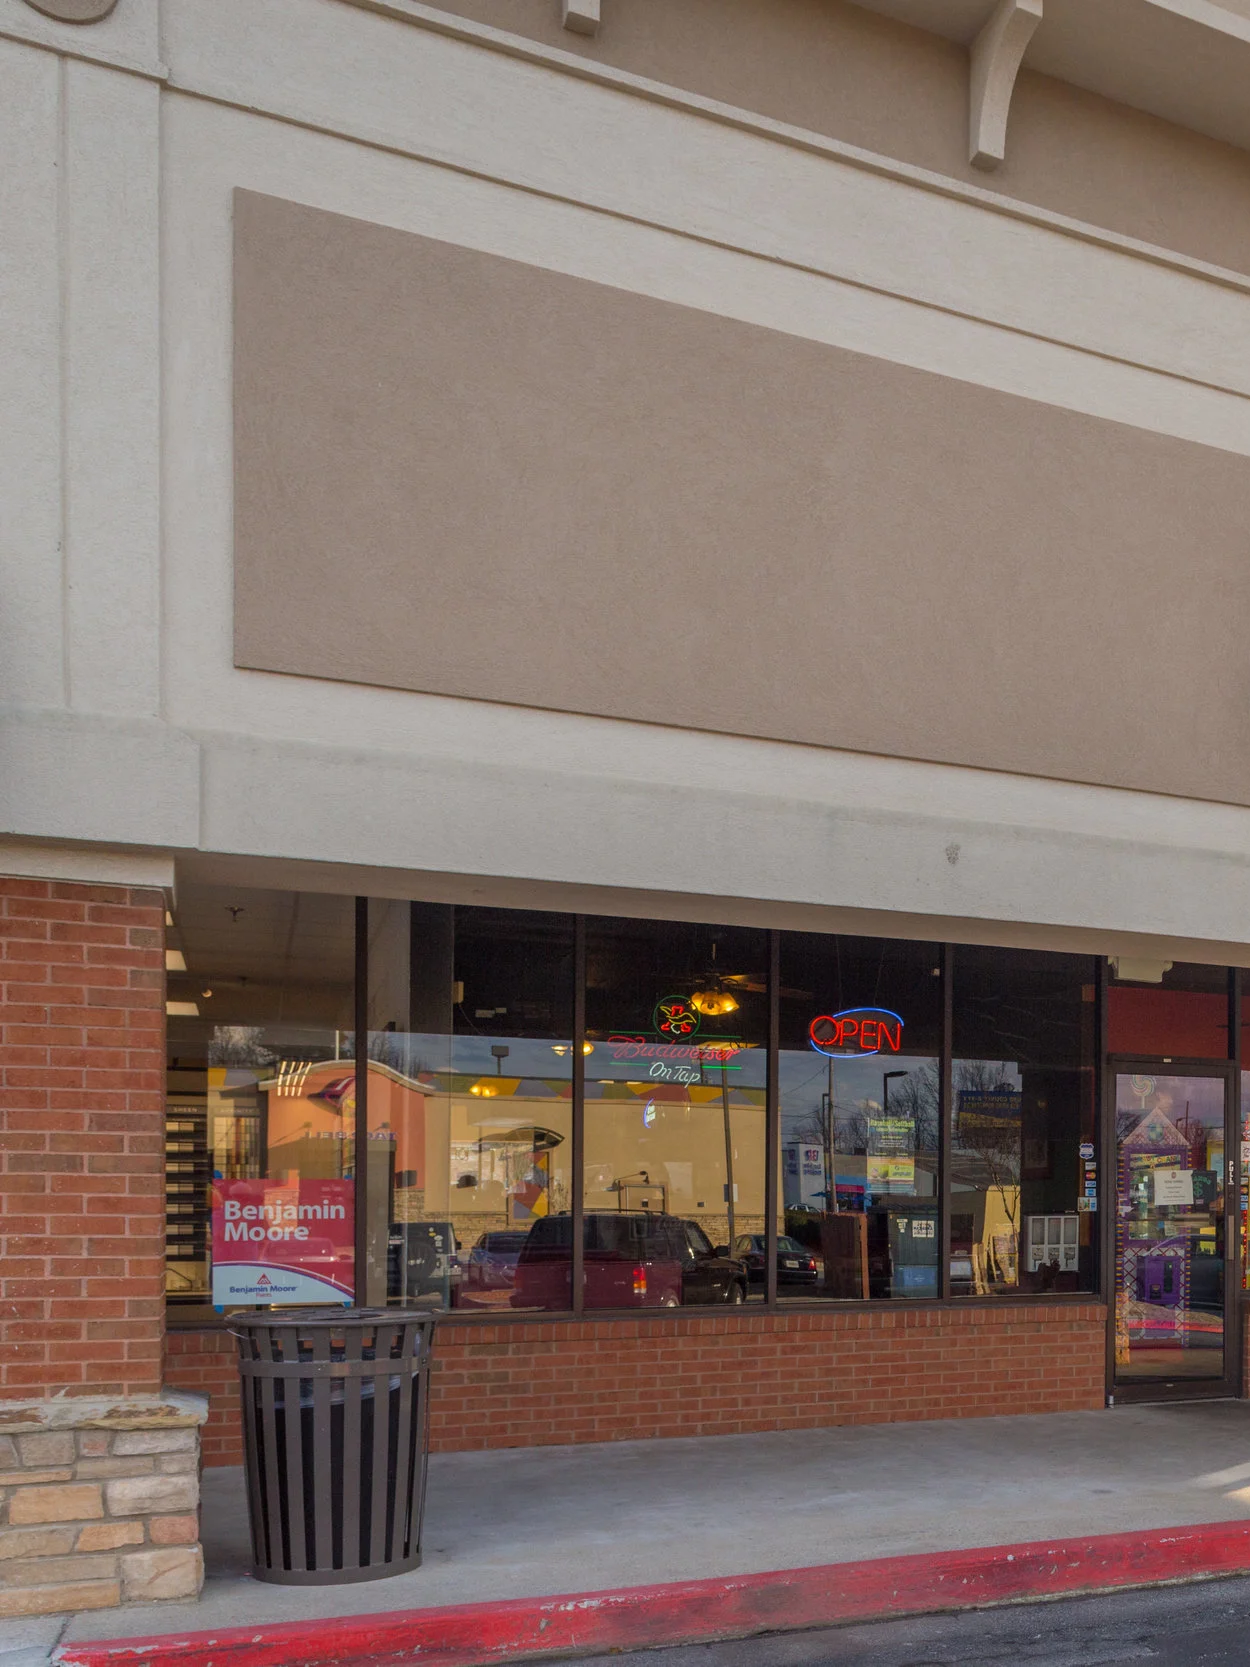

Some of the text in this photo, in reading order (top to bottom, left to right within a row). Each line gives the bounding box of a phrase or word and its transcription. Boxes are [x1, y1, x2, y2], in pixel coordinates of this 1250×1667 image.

[810, 1015, 901, 1051] OPEN
[607, 1036, 741, 1061] Budweiser
[649, 1062, 701, 1088] On Tap
[224, 1200, 345, 1225] Benjamin
[224, 1222, 309, 1242] Moore
[229, 1286, 268, 1295] Benjamin
